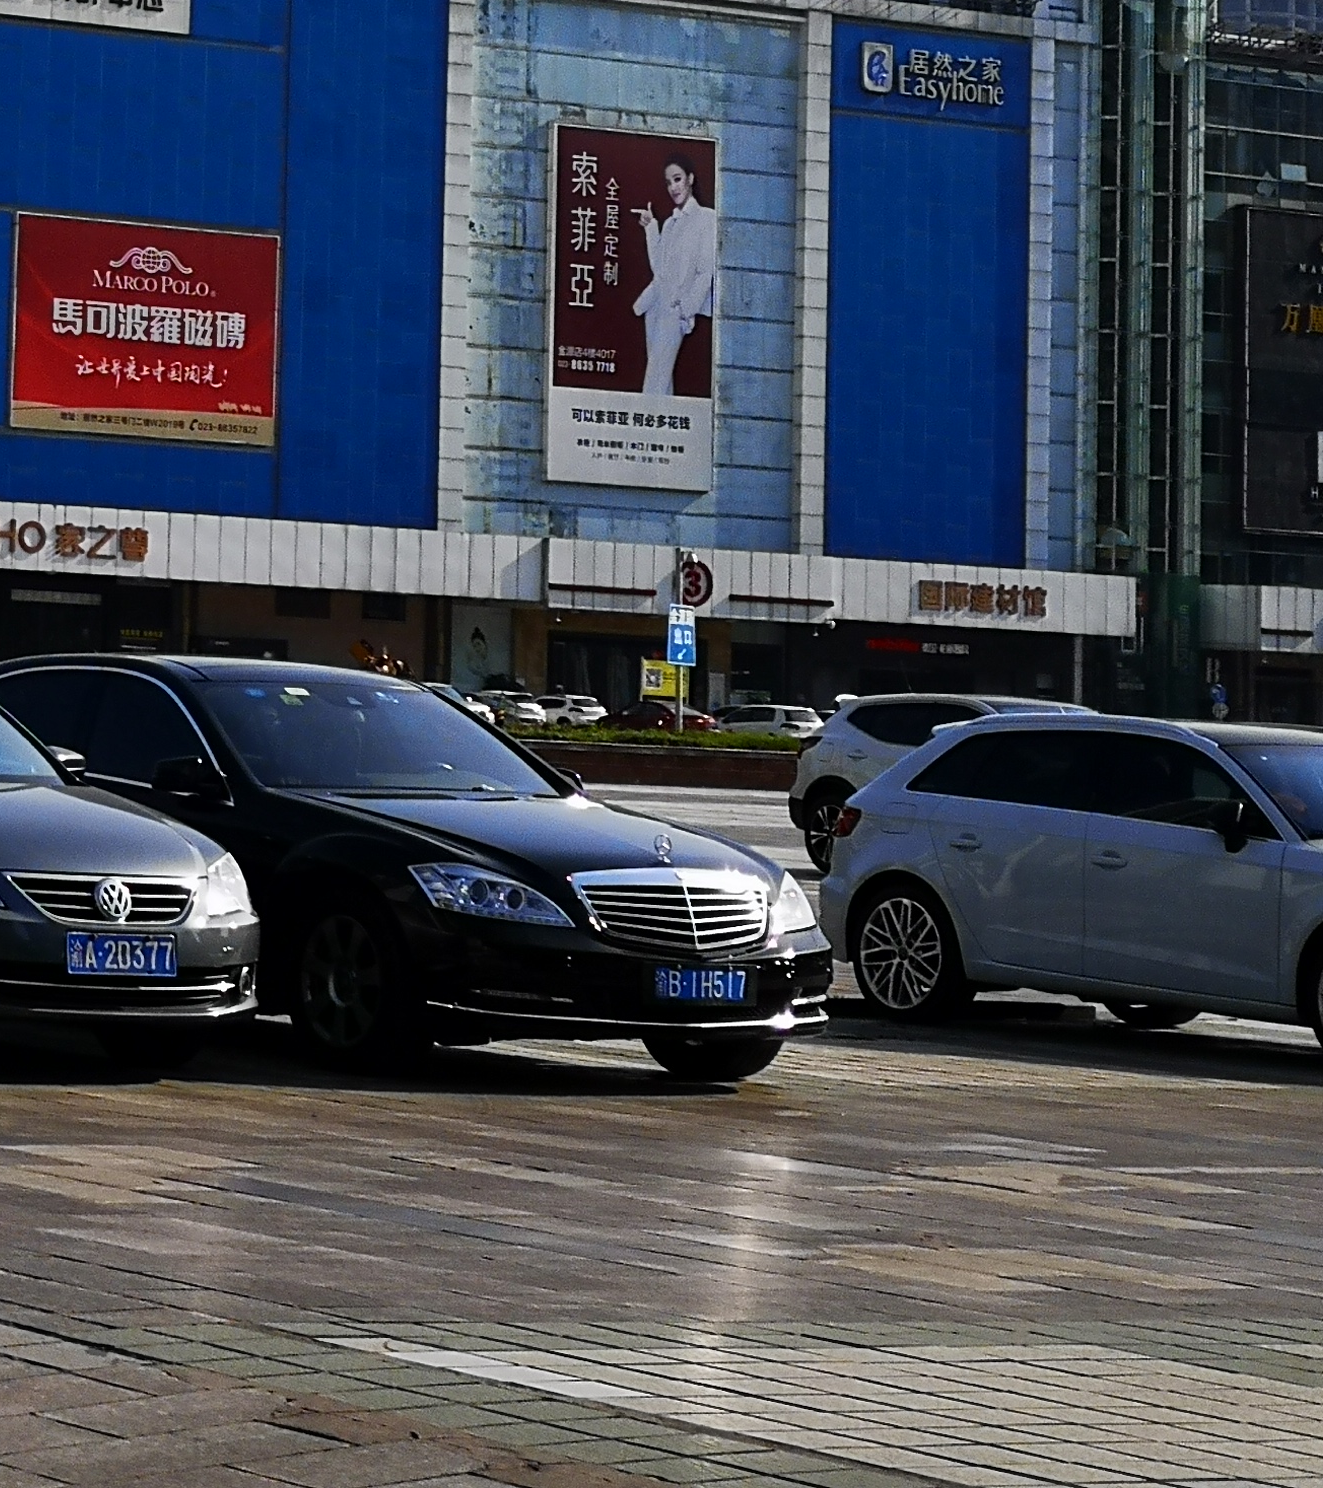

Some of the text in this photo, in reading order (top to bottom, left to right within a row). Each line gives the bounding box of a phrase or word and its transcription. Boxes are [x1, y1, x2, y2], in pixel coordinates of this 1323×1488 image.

[908, 48, 1003, 83] 居然之家
[898, 64, 1006, 111] Easyhome
[602, 176, 621, 287] 全屋定制
[92, 269, 210, 297] MARCO POLO
[571, 407, 691, 430] 可以索菲亚 何必多花钱
